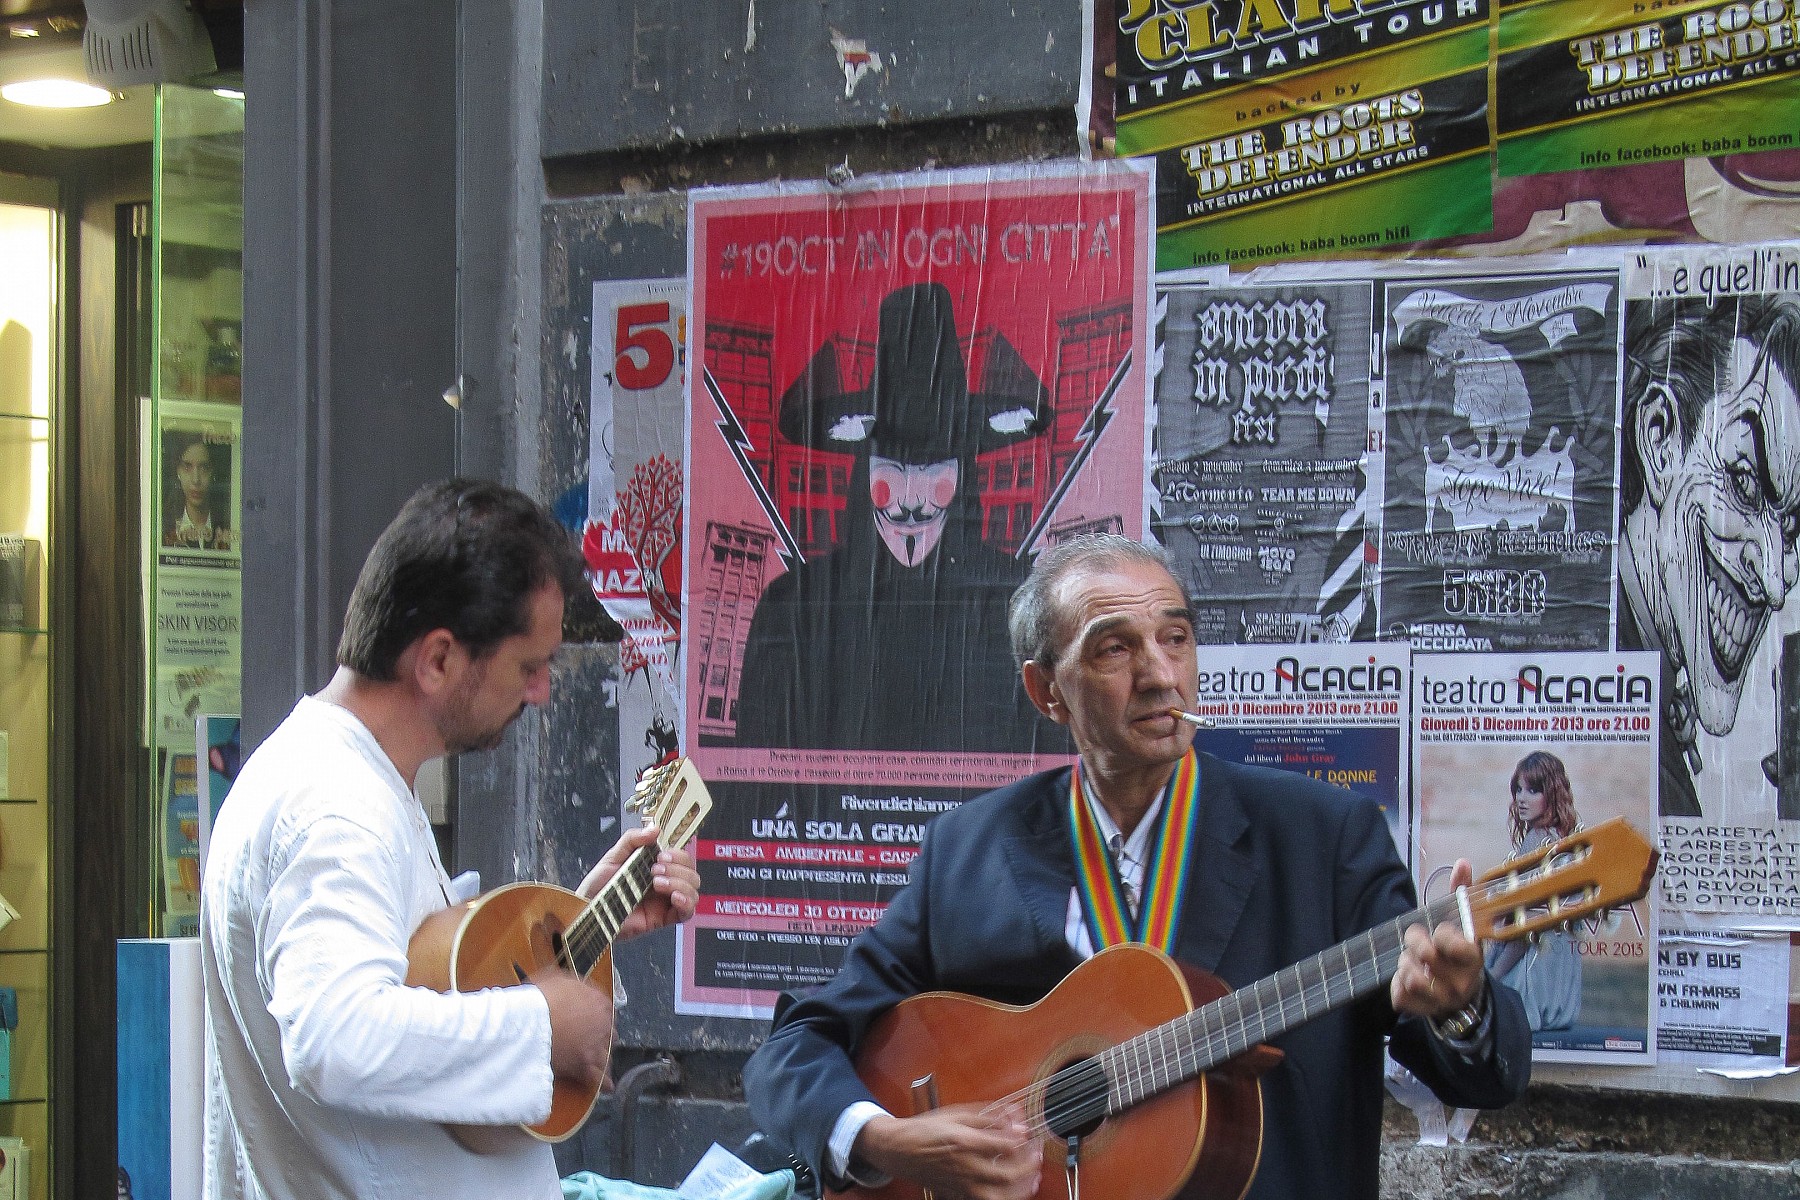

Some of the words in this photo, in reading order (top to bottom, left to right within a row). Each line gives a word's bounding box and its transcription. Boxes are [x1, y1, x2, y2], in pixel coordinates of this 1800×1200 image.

[1128, 35, 1320, 105] ITALIAN
[1353, 0, 1479, 44] TOUR
[1570, 22, 1665, 71] THE
[1576, 68, 1734, 112] INTERNATIONAL
[1742, 57, 1777, 77] ALL
[1234, 90, 1323, 122] backed
[1334, 80, 1362, 98] by
[1182, 129, 1267, 173] THE
[1282, 88, 1424, 148] ROOTS
[1580, 150, 1612, 165] info
[1617, 140, 1697, 161] facebook:
[1702, 135, 1742, 151] baba
[1748, 131, 1793, 148] boom
[1197, 118, 1415, 199] DEFENDER
[1186, 172, 1328, 216] INTERNATIONAL
[1334, 161, 1366, 181] ALL
[1372, 144, 1429, 171] STARS
[857, 229, 891, 271] IN
[903, 224, 988, 269] OGNI
[1192, 251, 1221, 266] info
[1225, 242, 1296, 261] facebook:
[1300, 236, 1336, 251] baba
[1340, 231, 1381, 246] boom
[614, 300, 675, 390] 5
[1261, 487, 1295, 503] TEAR
[1297, 487, 1316, 503] ME
[194, 613, 239, 633] VISOR
[1410, 623, 1467, 637] MENSA
[1411, 637, 1493, 650] OCCUPATA
[1198, 666, 1265, 693] eatro
[1421, 675, 1506, 705] teatro
[1231, 702, 1240, 715] 9
[1243, 702, 1305, 715] Dicembre
[1307, 702, 1337, 715] 2013
[1340, 704, 1361, 715] ore
[1364, 701, 1399, 715] 21.00
[1472, 716, 1480, 732] 5
[1483, 716, 1549, 732] Dicembre
[1551, 716, 1584, 732] 2013
[1587, 718, 1611, 732] ore
[1613, 716, 1651, 732] 21.00
[724, 766, 748, 776] Roma
[1327, 769, 1377, 783] DONNE
[805, 820, 865, 842] SOLA
[714, 843, 765, 858] DIFESA
[775, 846, 865, 864] AMBIENTALE
[1680, 840, 1800, 853] ARRESTAT
[1660, 852, 1796, 866] ROCESSATI
[727, 866, 756, 880] NON
[759, 868, 772, 881] CI
[776, 868, 867, 885] RAPPRESENTA
[870, 873, 911, 886] NESSU
[1659, 865, 1800, 880] ONDANNAT
[1663, 879, 1688, 891] LA
[1698, 880, 1799, 894] RIVOLTA
[1568, 940, 1608, 956] TOUR
[1613, 941, 1644, 957] 2013
[1676, 951, 1700, 967] BY
[1706, 952, 1741, 969] BUS
